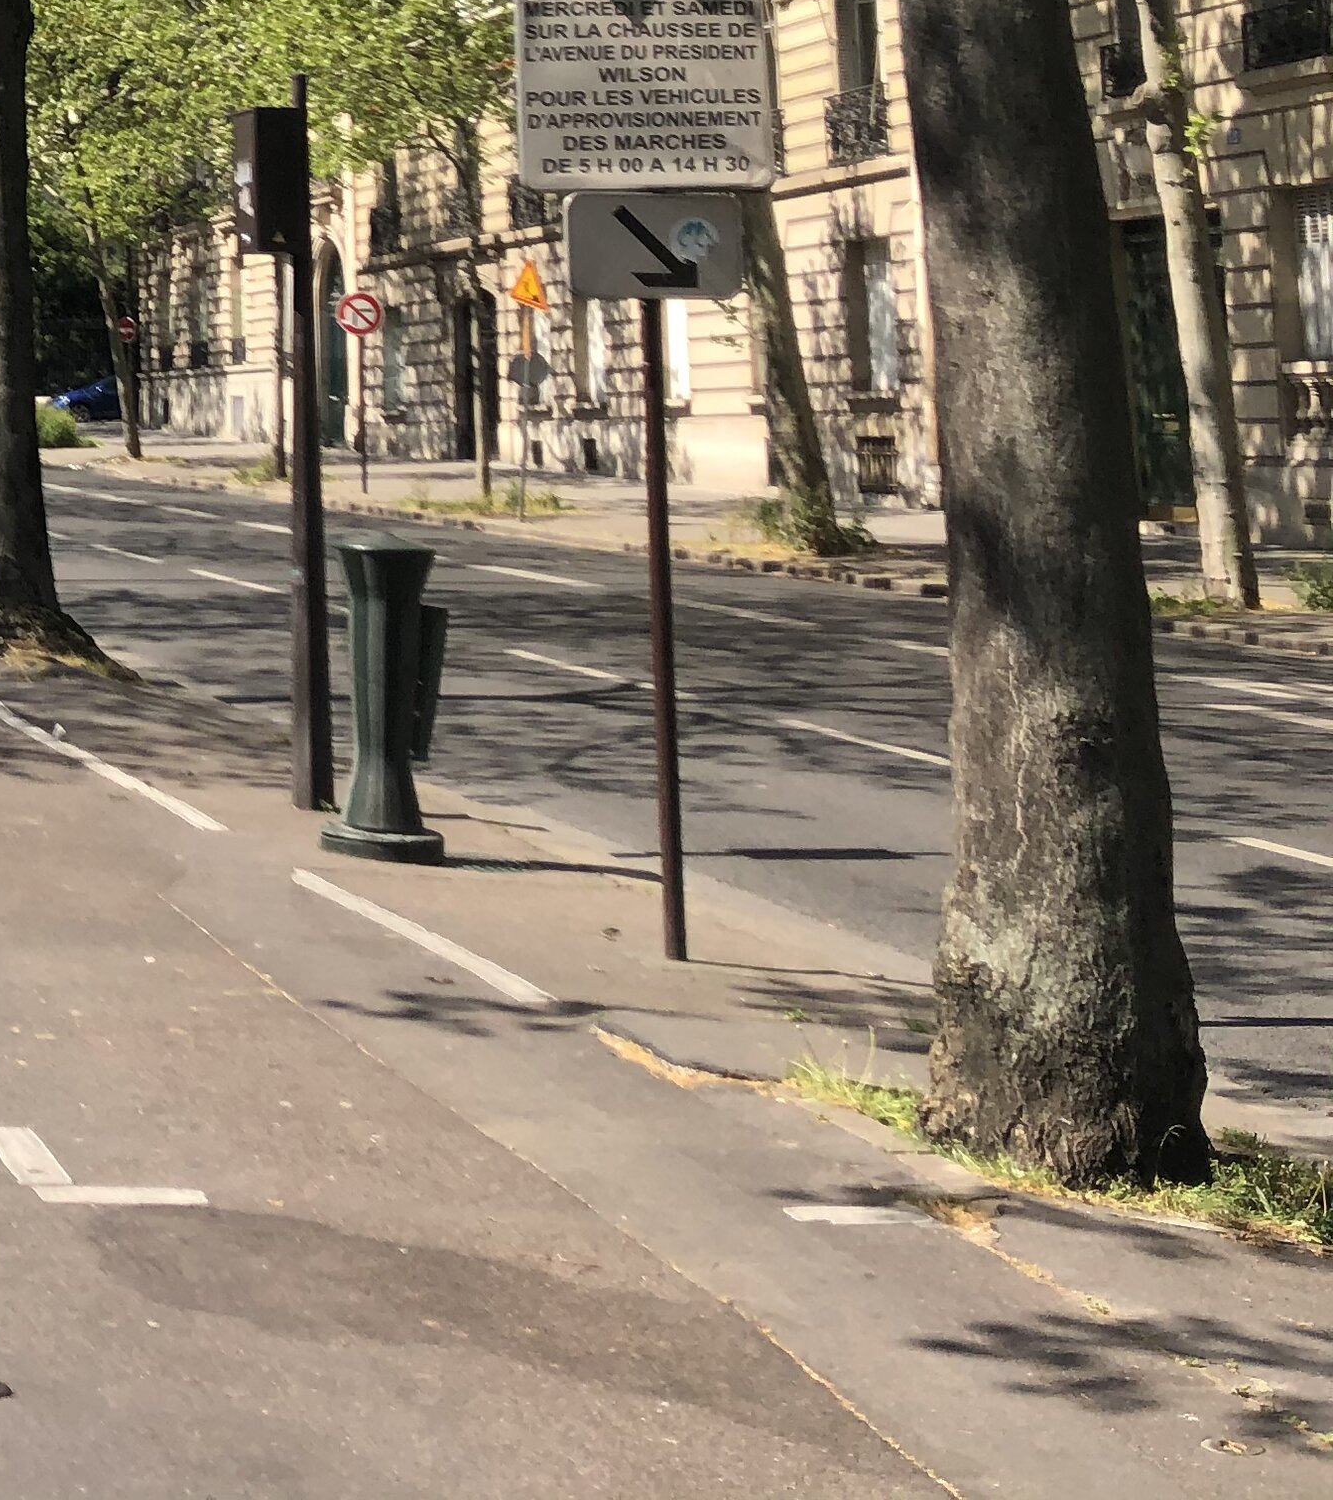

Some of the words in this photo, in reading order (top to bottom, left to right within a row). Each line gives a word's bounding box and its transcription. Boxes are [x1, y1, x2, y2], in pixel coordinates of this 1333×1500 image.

[524, 1, 633, 16] MERCREDI
[641, 1, 666, 15] ET
[673, 1, 754, 15] SAMEDI
[525, 23, 568, 39] SUR
[574, 23, 602, 38] LA
[607, 22, 721, 38] CHAUSSEE
[728, 22, 756, 38] DE
[524, 45, 615, 62] L'AVENUE
[621, 44, 647, 60] DU
[652, 44, 757, 60] PRESIDENT
[598, 66, 686, 83] WILSON
[525, 90, 587, 107] POUR
[592, 89, 633, 106] LES
[639, 88, 761, 104] VEHICULES
[527, 111, 761, 129] D'APPROVISIONNEMENT
[562, 135, 608, 151] DES
[614, 133, 727, 151] MARCHES
[542, 158, 572, 173] DE
[578, 158, 591, 173] 5
[597, 158, 613, 173] H
[619, 157, 644, 173] 00
[649, 157, 666, 172] A
[672, 156, 696, 172] 14
[702, 156, 718, 172] H
[725, 155, 750, 172] 30
